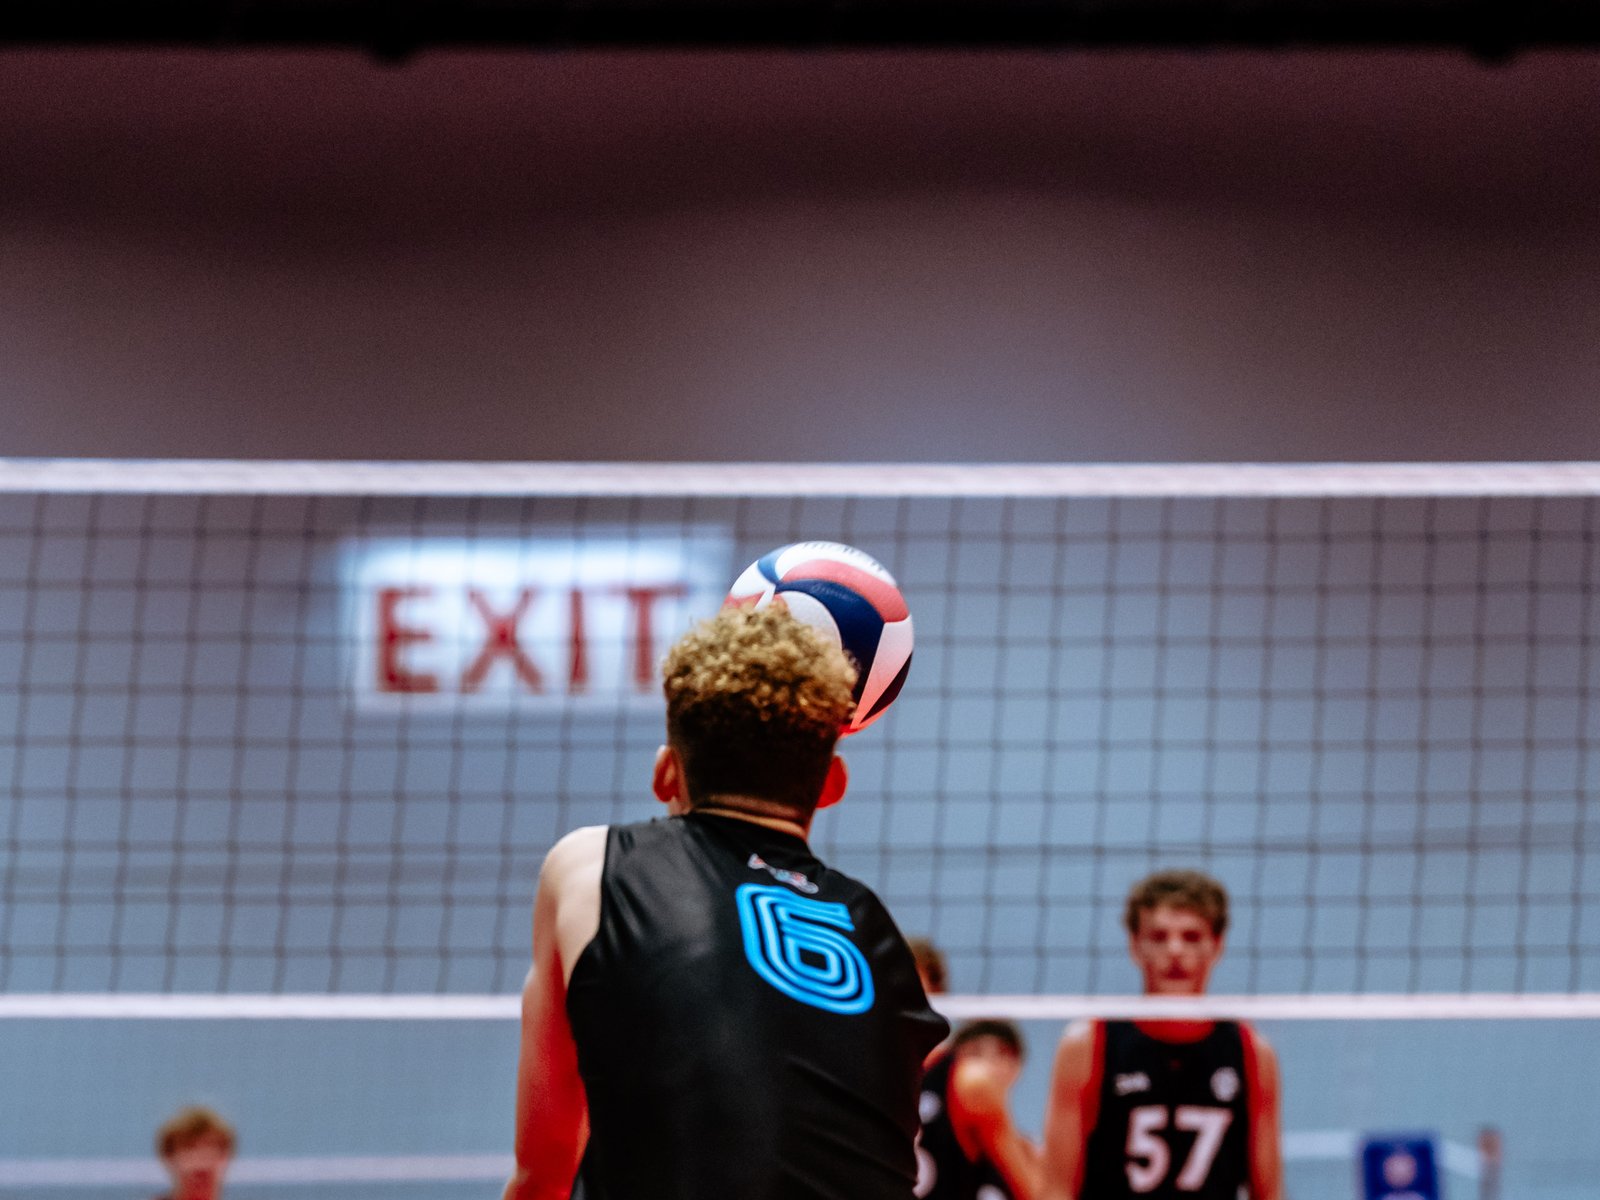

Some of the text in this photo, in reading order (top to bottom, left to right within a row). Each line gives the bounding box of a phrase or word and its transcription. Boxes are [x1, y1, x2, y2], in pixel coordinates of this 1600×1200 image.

[375, 586, 687, 694] EXIT
[735, 882, 876, 1015] 6
[1126, 1104, 1233, 1193] 57
